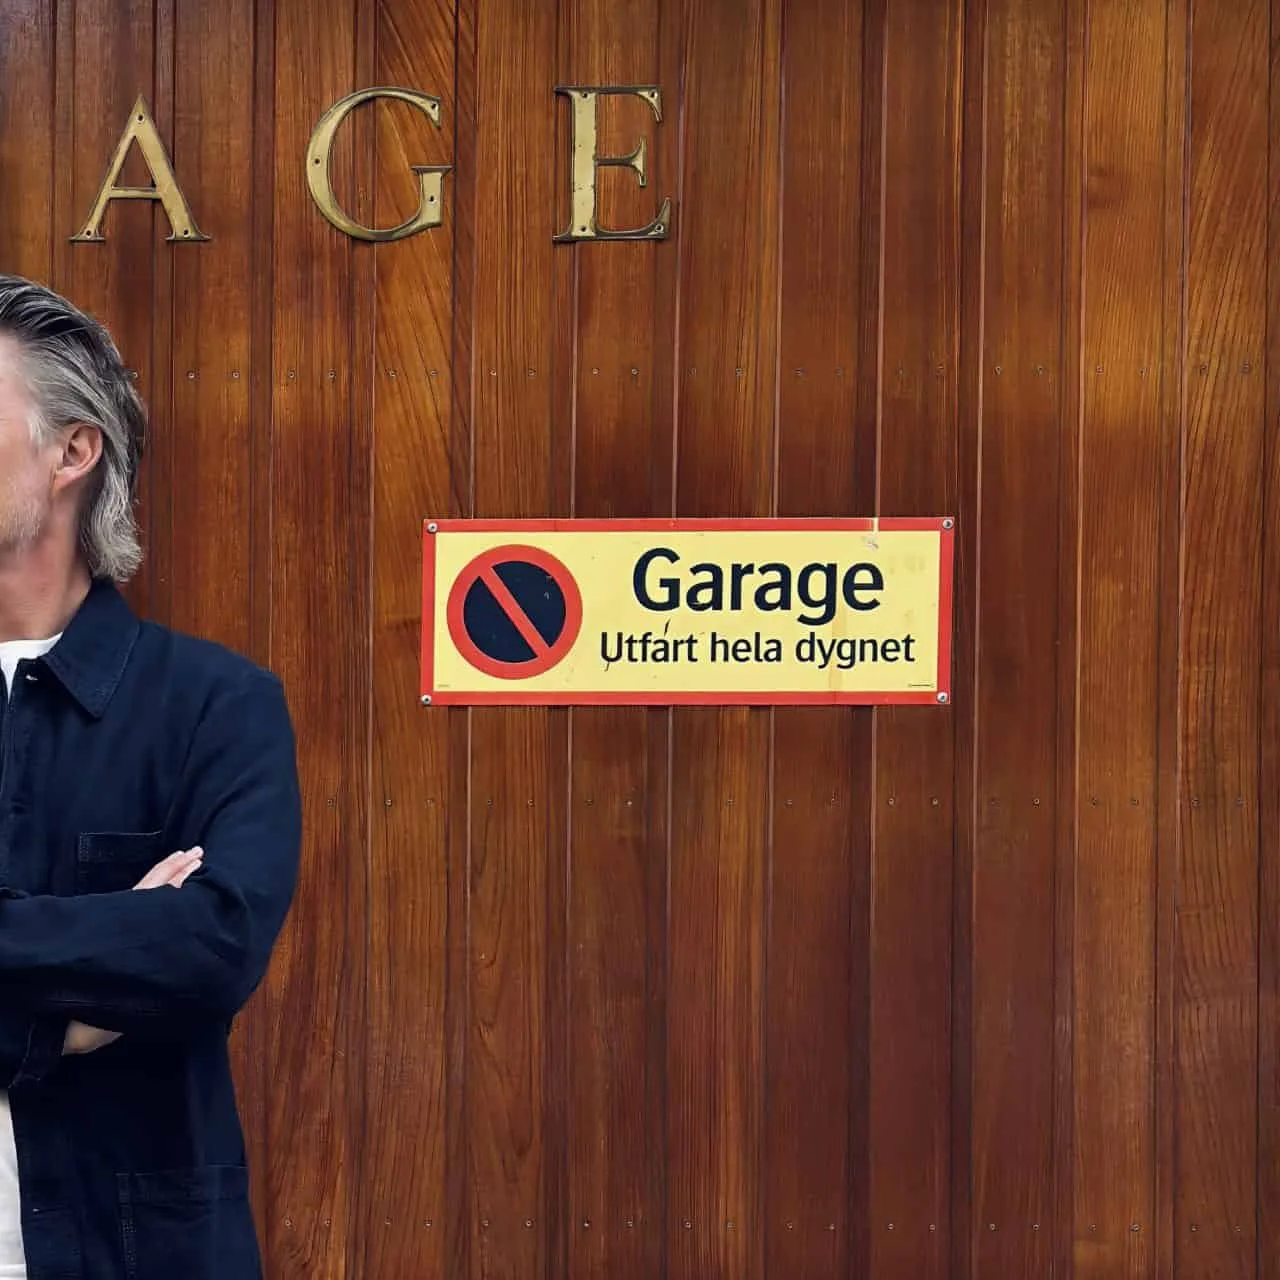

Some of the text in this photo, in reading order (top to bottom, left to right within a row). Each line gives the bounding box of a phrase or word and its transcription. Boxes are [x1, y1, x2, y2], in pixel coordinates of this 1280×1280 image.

[632, 547, 884, 625] Garage
[600, 631, 916, 669] Utfart hela dygnet
